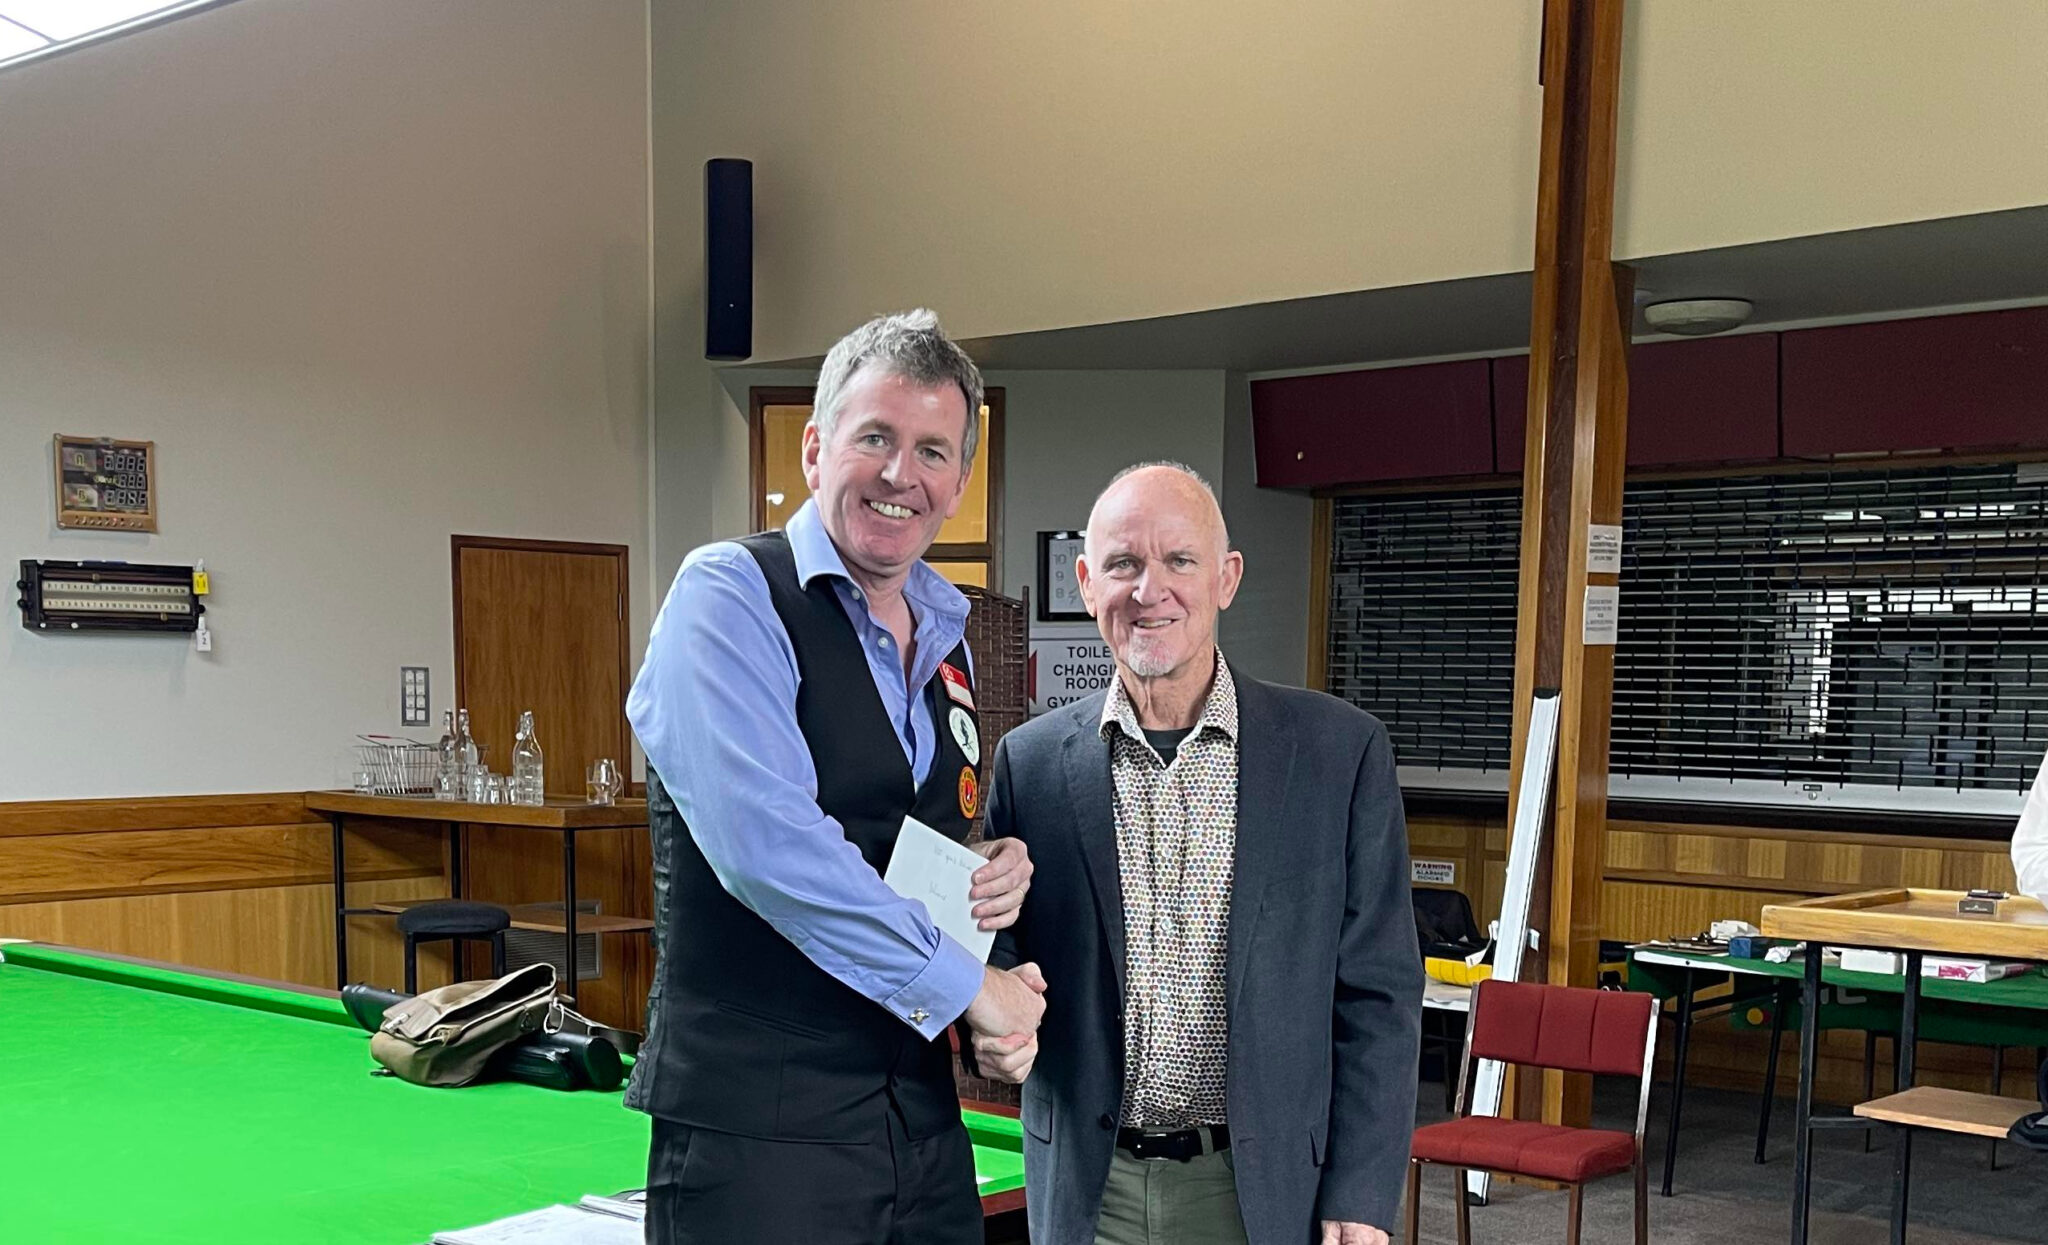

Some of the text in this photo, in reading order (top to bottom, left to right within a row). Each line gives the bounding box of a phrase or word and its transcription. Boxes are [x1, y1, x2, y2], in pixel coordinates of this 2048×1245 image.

[1053, 553, 1067, 565] 10
[1055, 570, 1064, 582] 9
[1055, 587, 1065, 599] 8
[1066, 646, 1111, 658] TOILE
[1047, 696, 1083, 709] GYM
